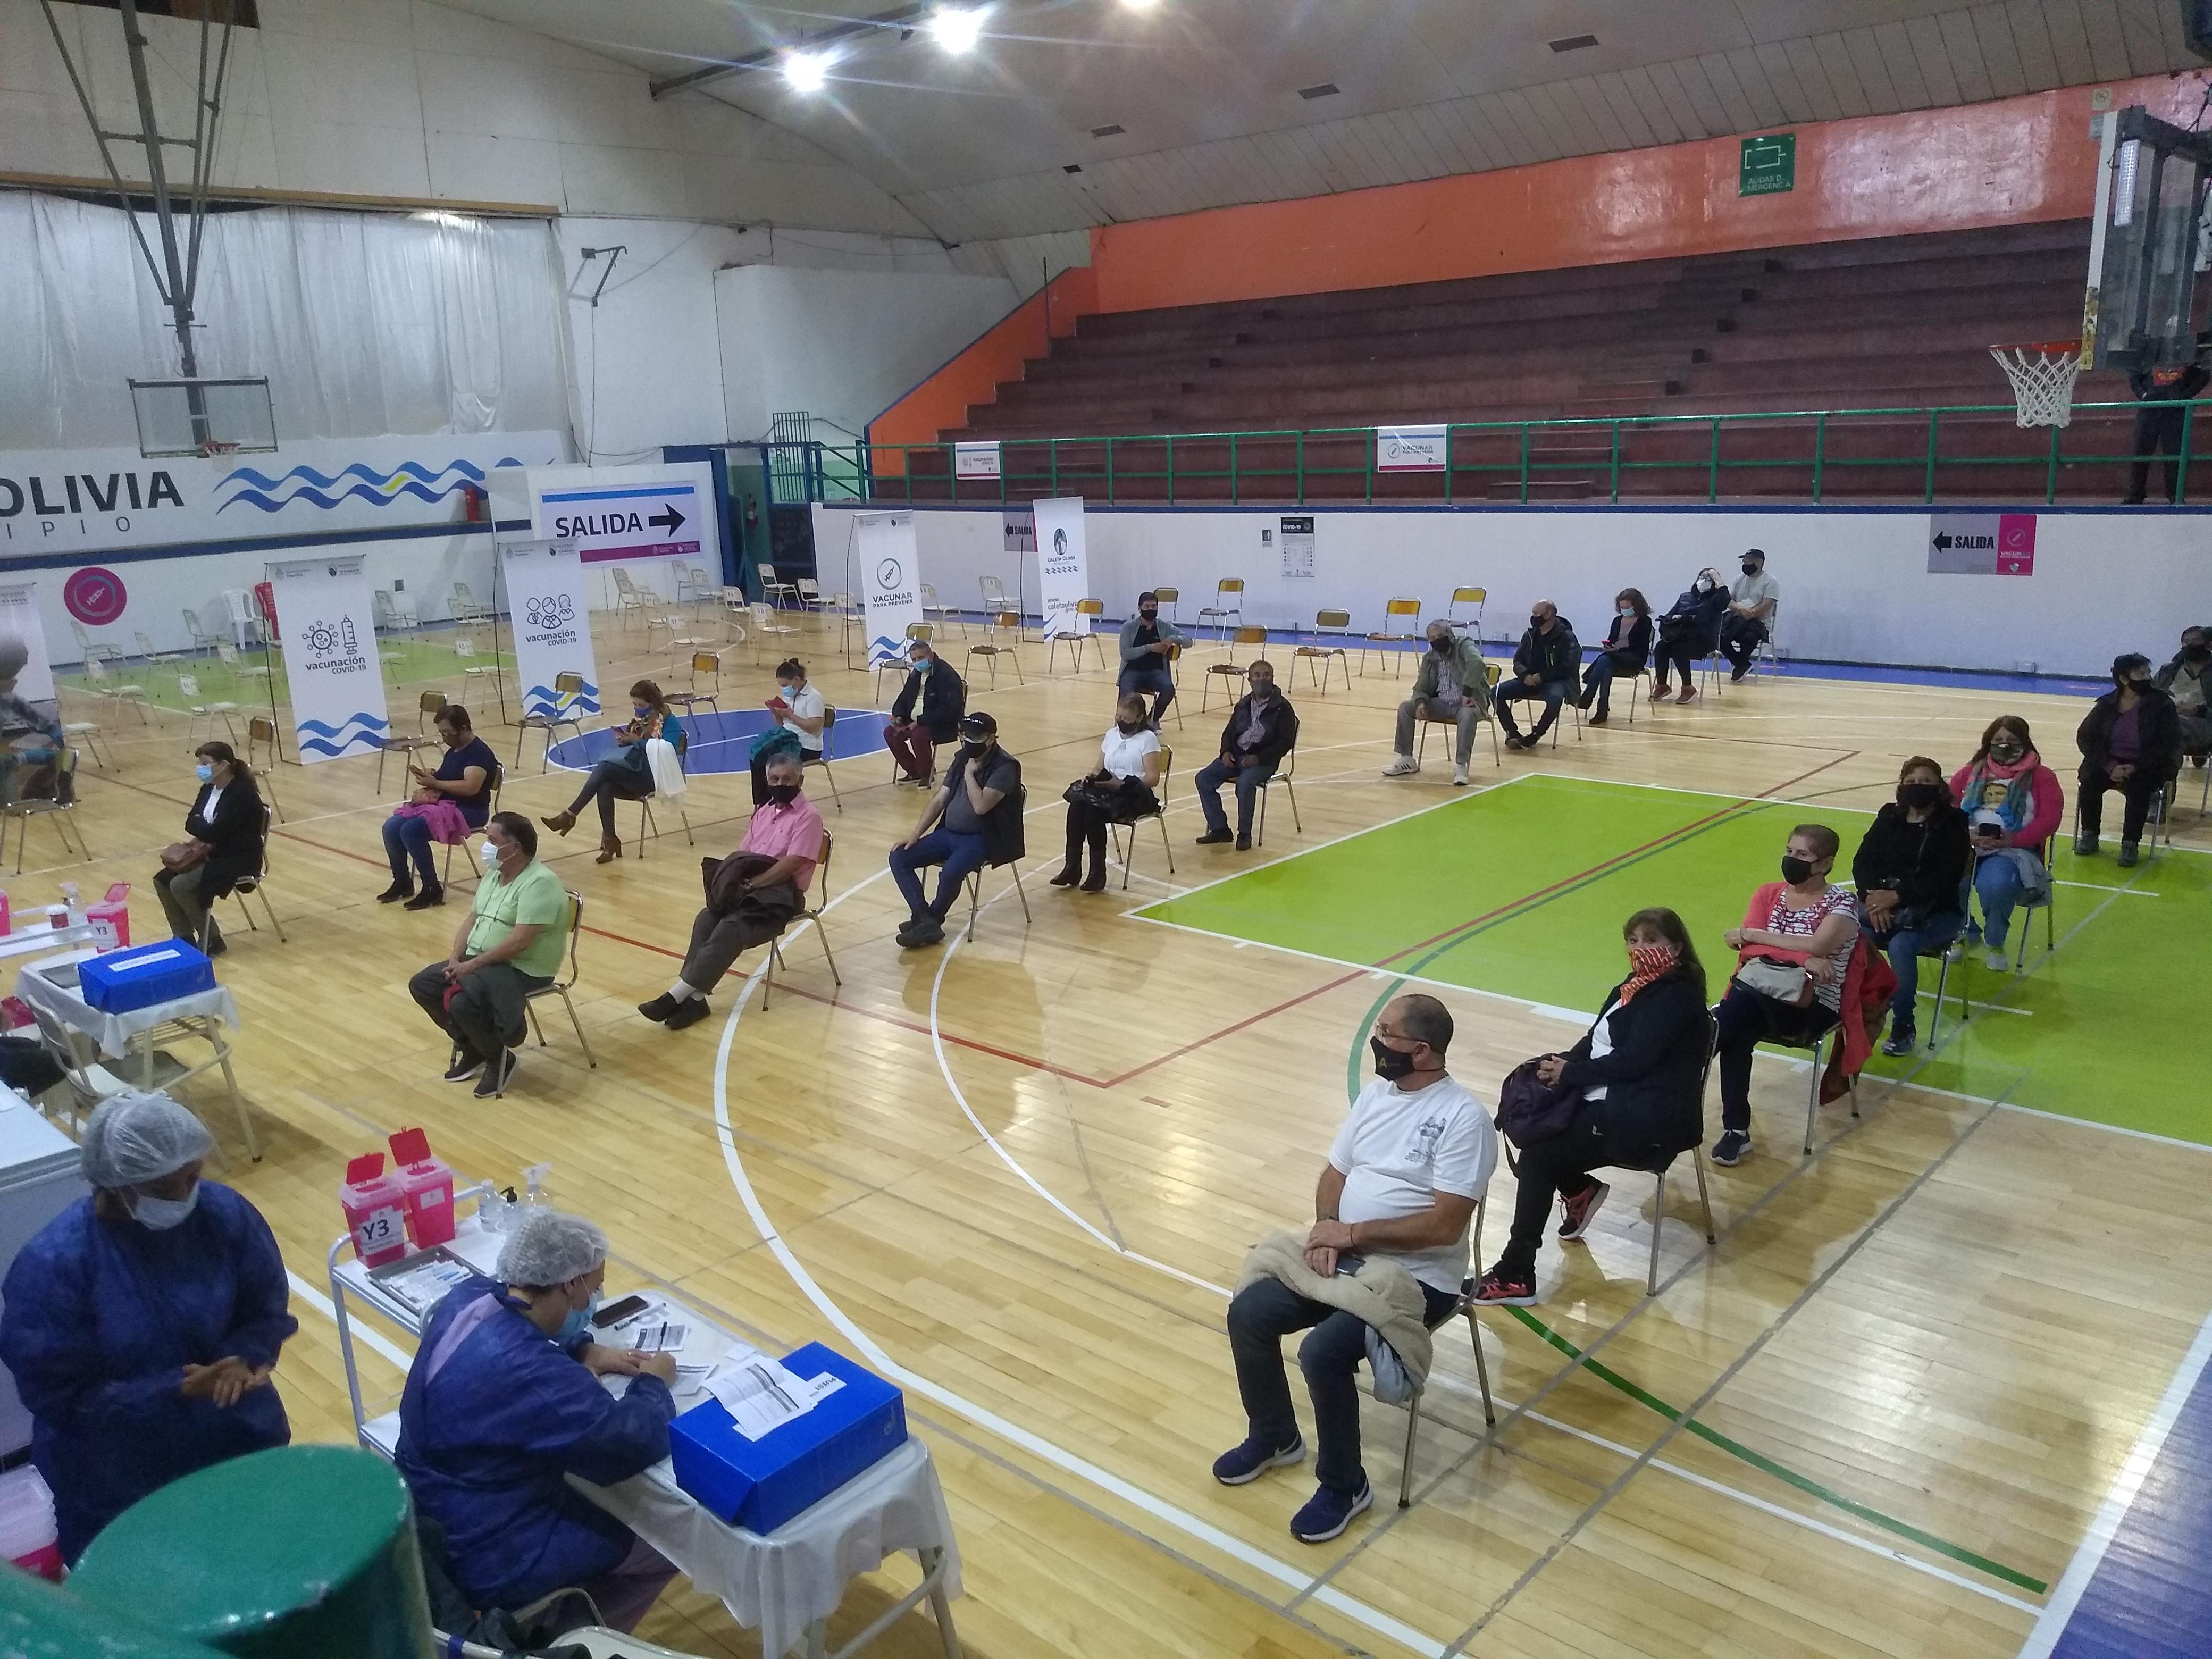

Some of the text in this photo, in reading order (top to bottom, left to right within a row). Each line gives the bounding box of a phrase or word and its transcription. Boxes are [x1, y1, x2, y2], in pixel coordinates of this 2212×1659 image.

[555, 513, 643, 538] SALIDA
[1015, 526, 1032, 535] SALIDA
[1955, 535, 1994, 549] SALIDA
[873, 592, 912, 603] VACUNAR
[526, 629, 576, 642] vacunación
[548, 637, 577, 646] COVID-19
[305, 655, 365, 670] vacunación
[332, 664, 366, 674] COVID-19
[362, 1219, 390, 1240] Y3
